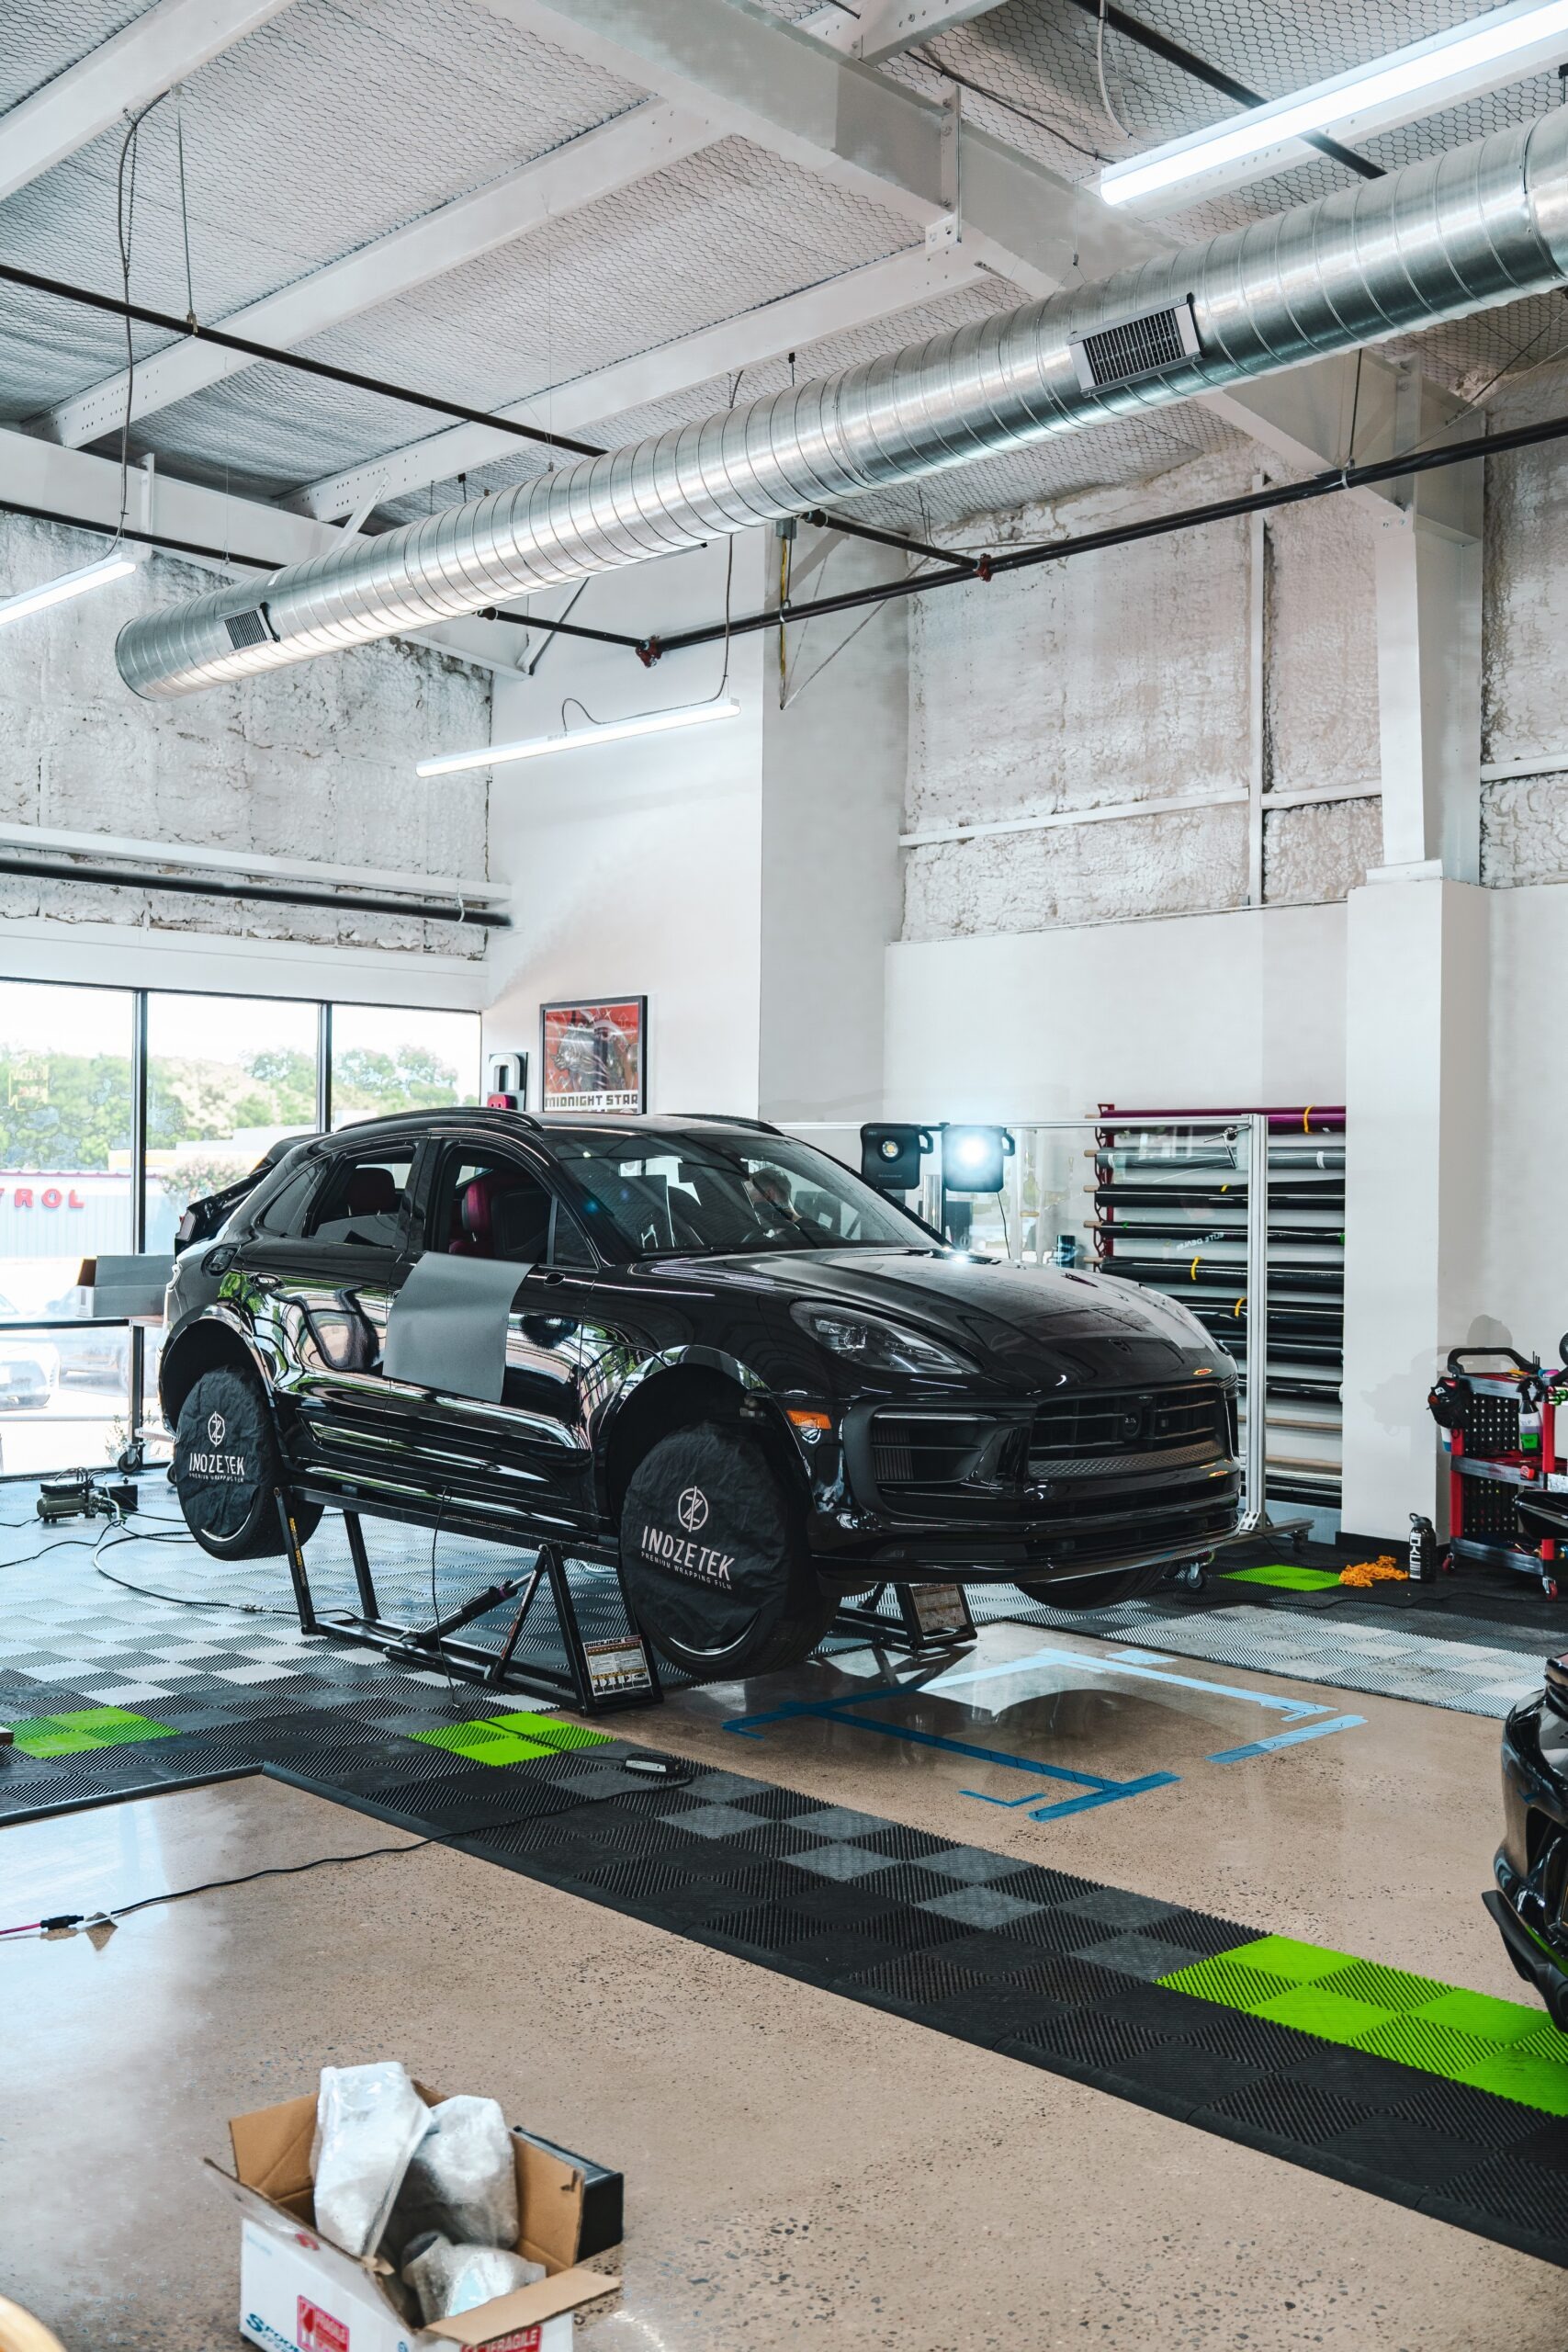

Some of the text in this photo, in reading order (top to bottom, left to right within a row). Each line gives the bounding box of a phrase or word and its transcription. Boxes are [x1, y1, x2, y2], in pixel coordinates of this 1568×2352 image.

[545, 1094, 637, 1107] MIDNIGHT STAR
[189, 1453, 245, 1476] INOZETEK
[641, 1525, 735, 1581] INOZETEK
[641, 1551, 732, 1590] PREMIUM WRAPPING FILM
